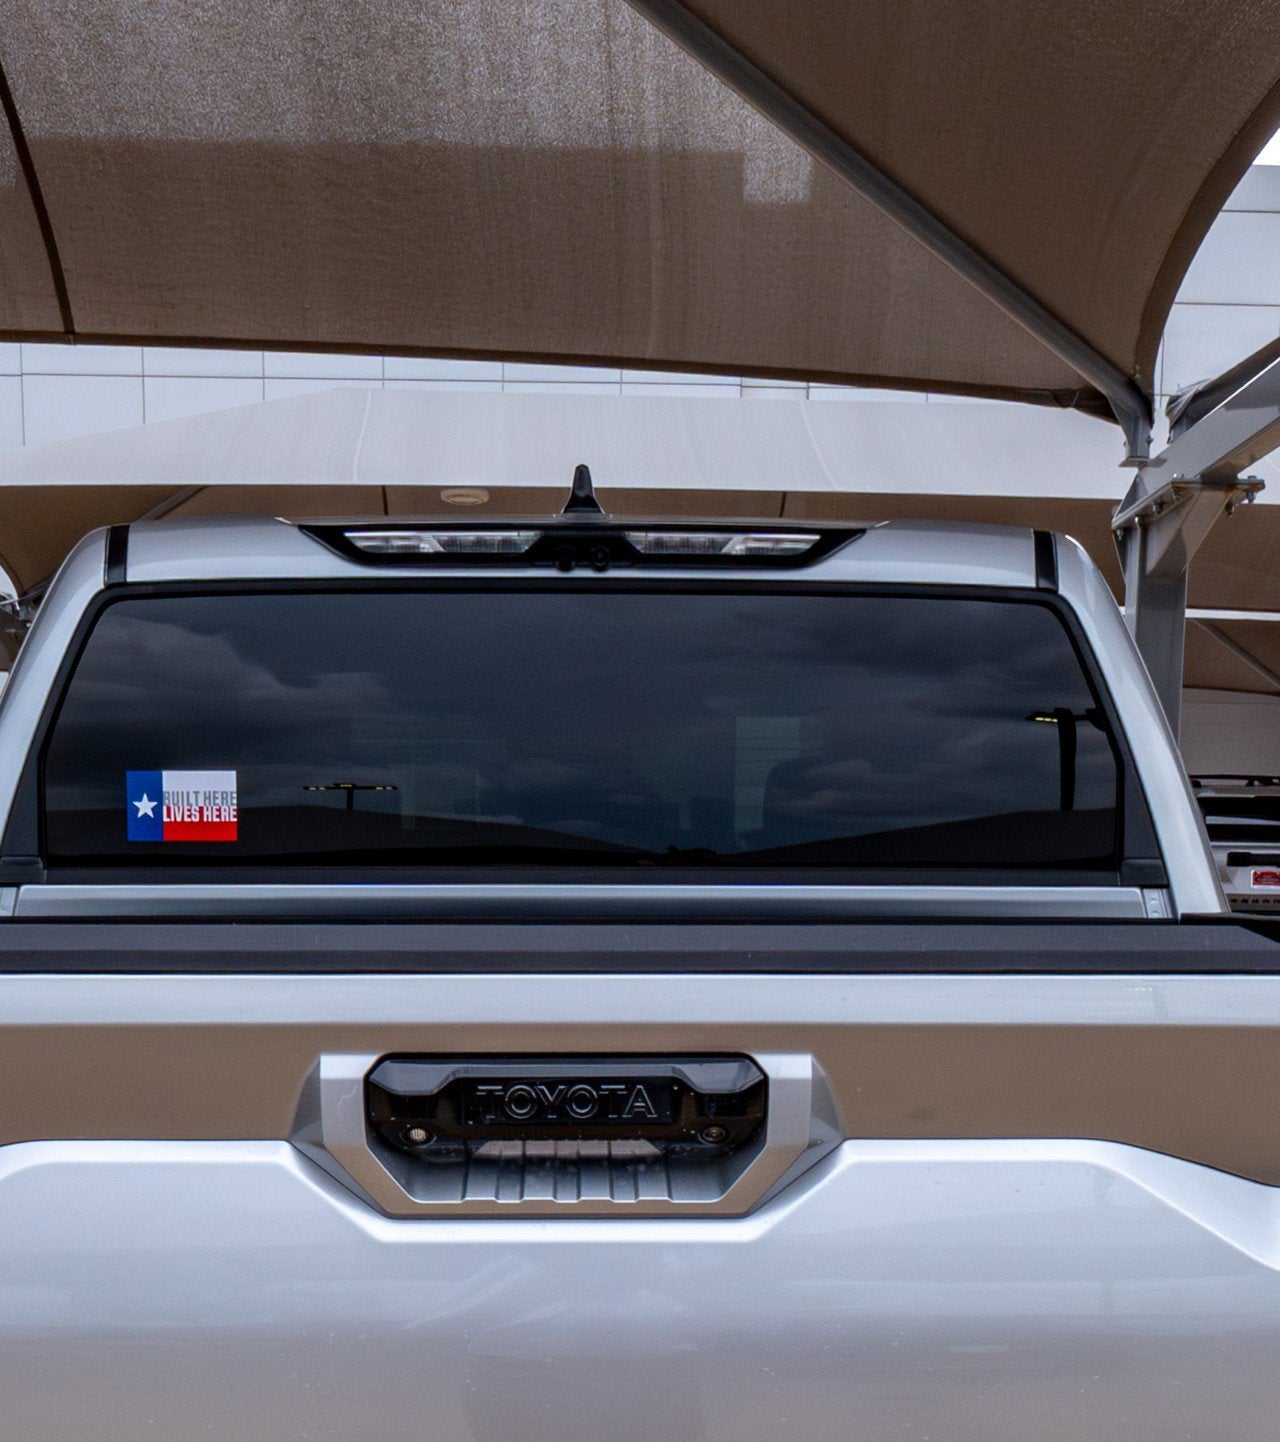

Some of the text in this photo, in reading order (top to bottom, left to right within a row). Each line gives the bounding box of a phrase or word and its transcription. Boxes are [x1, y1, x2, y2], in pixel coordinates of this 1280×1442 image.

[163, 790, 237, 806] BUILT HERE
[163, 805, 237, 822] LIVES HERE
[476, 1084, 659, 1119] TOYOTA
